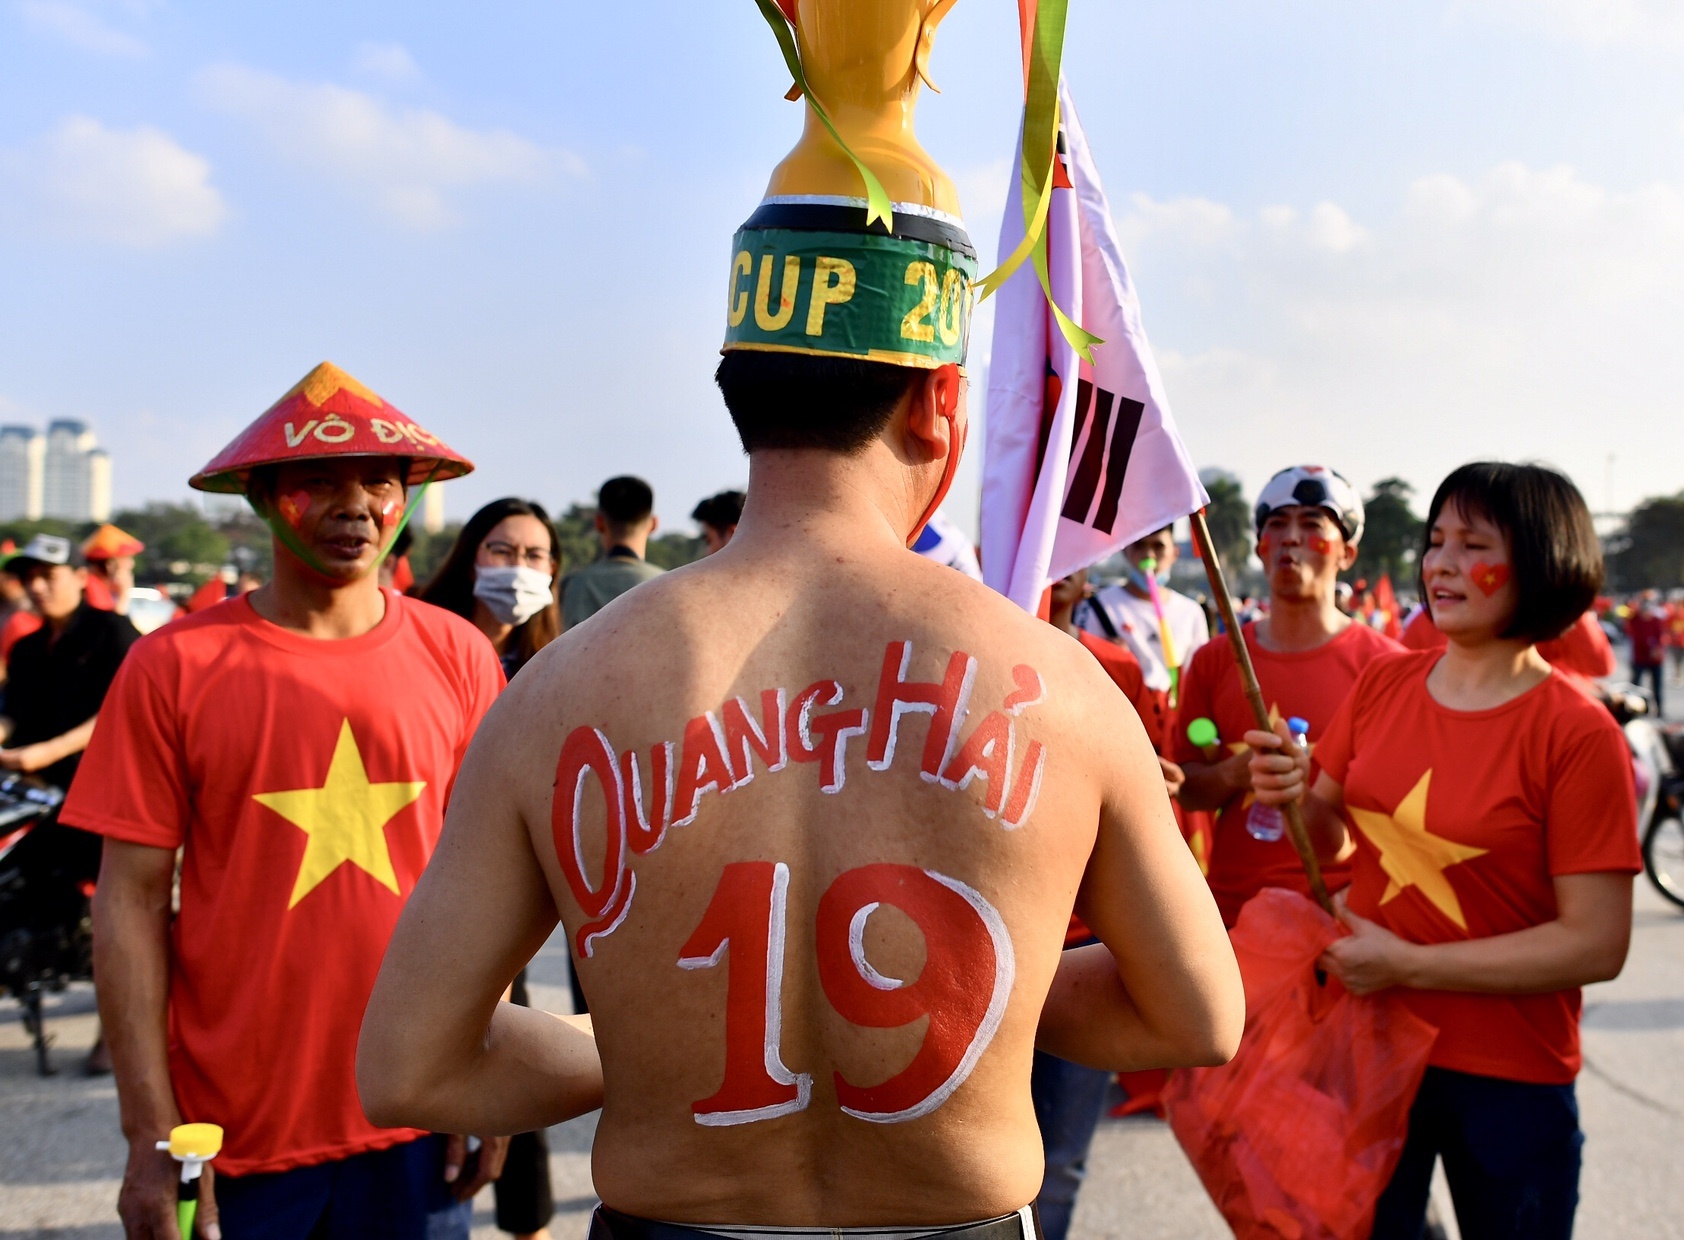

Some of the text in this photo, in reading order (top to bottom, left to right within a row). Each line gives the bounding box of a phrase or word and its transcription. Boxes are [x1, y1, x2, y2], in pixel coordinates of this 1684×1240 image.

[728, 250, 857, 337] CUP
[284, 412, 448, 451] VÔ ĐỊC
[676, 861, 1015, 1127] 19
